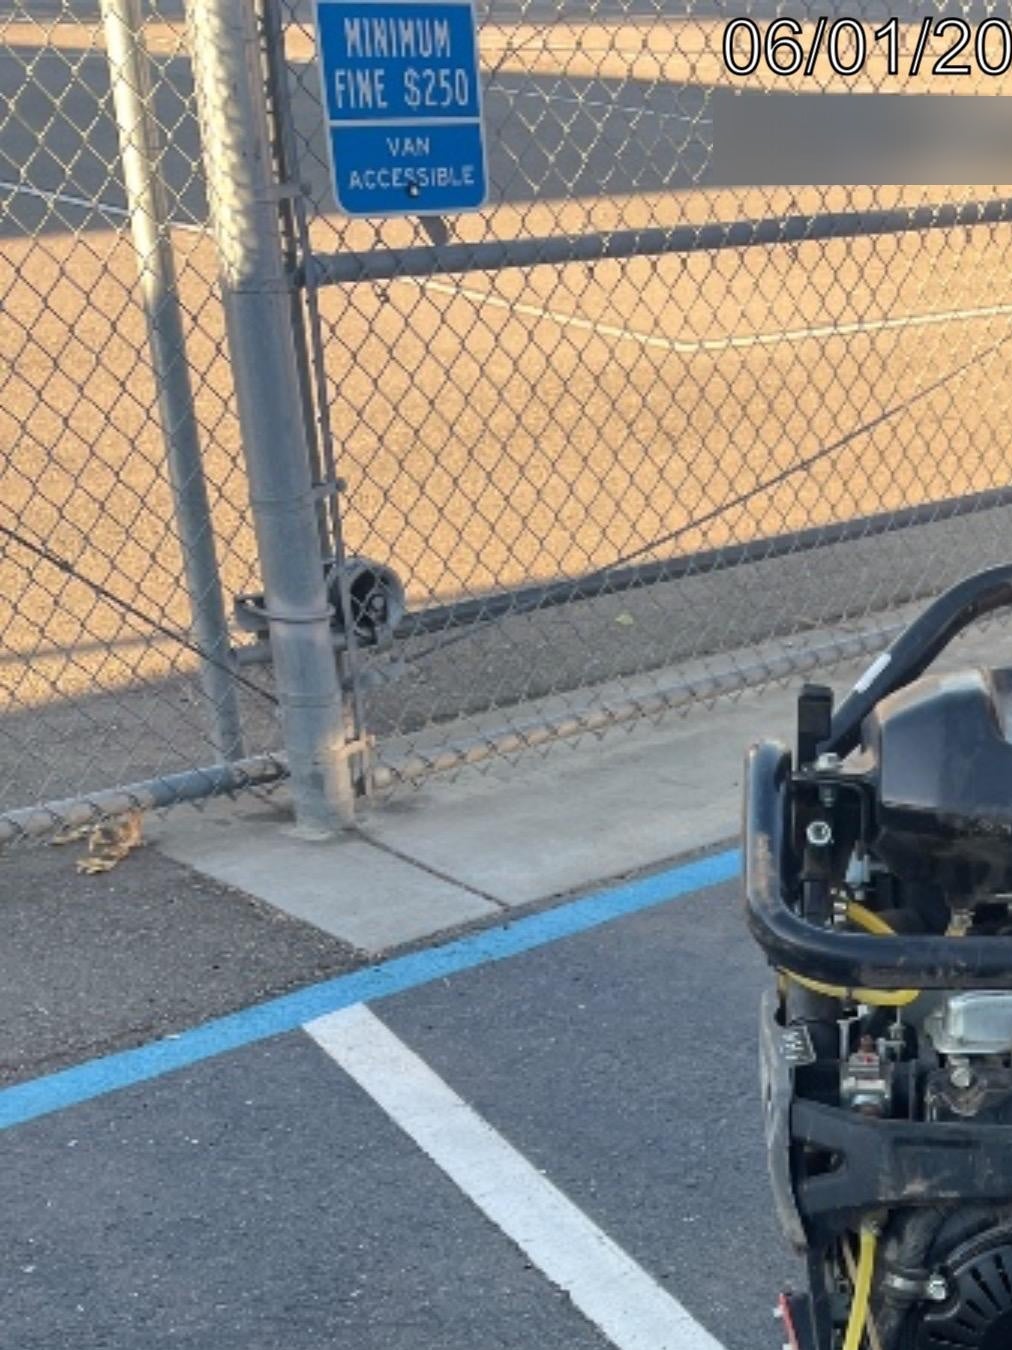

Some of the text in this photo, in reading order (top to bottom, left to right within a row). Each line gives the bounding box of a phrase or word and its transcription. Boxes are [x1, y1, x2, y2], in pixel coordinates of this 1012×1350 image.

[343, 17, 451, 58] MINIMUM
[334, 66, 469, 111] FINE $250
[386, 136, 430, 157] VAN
[349, 164, 475, 190] ACCESSIBLE
